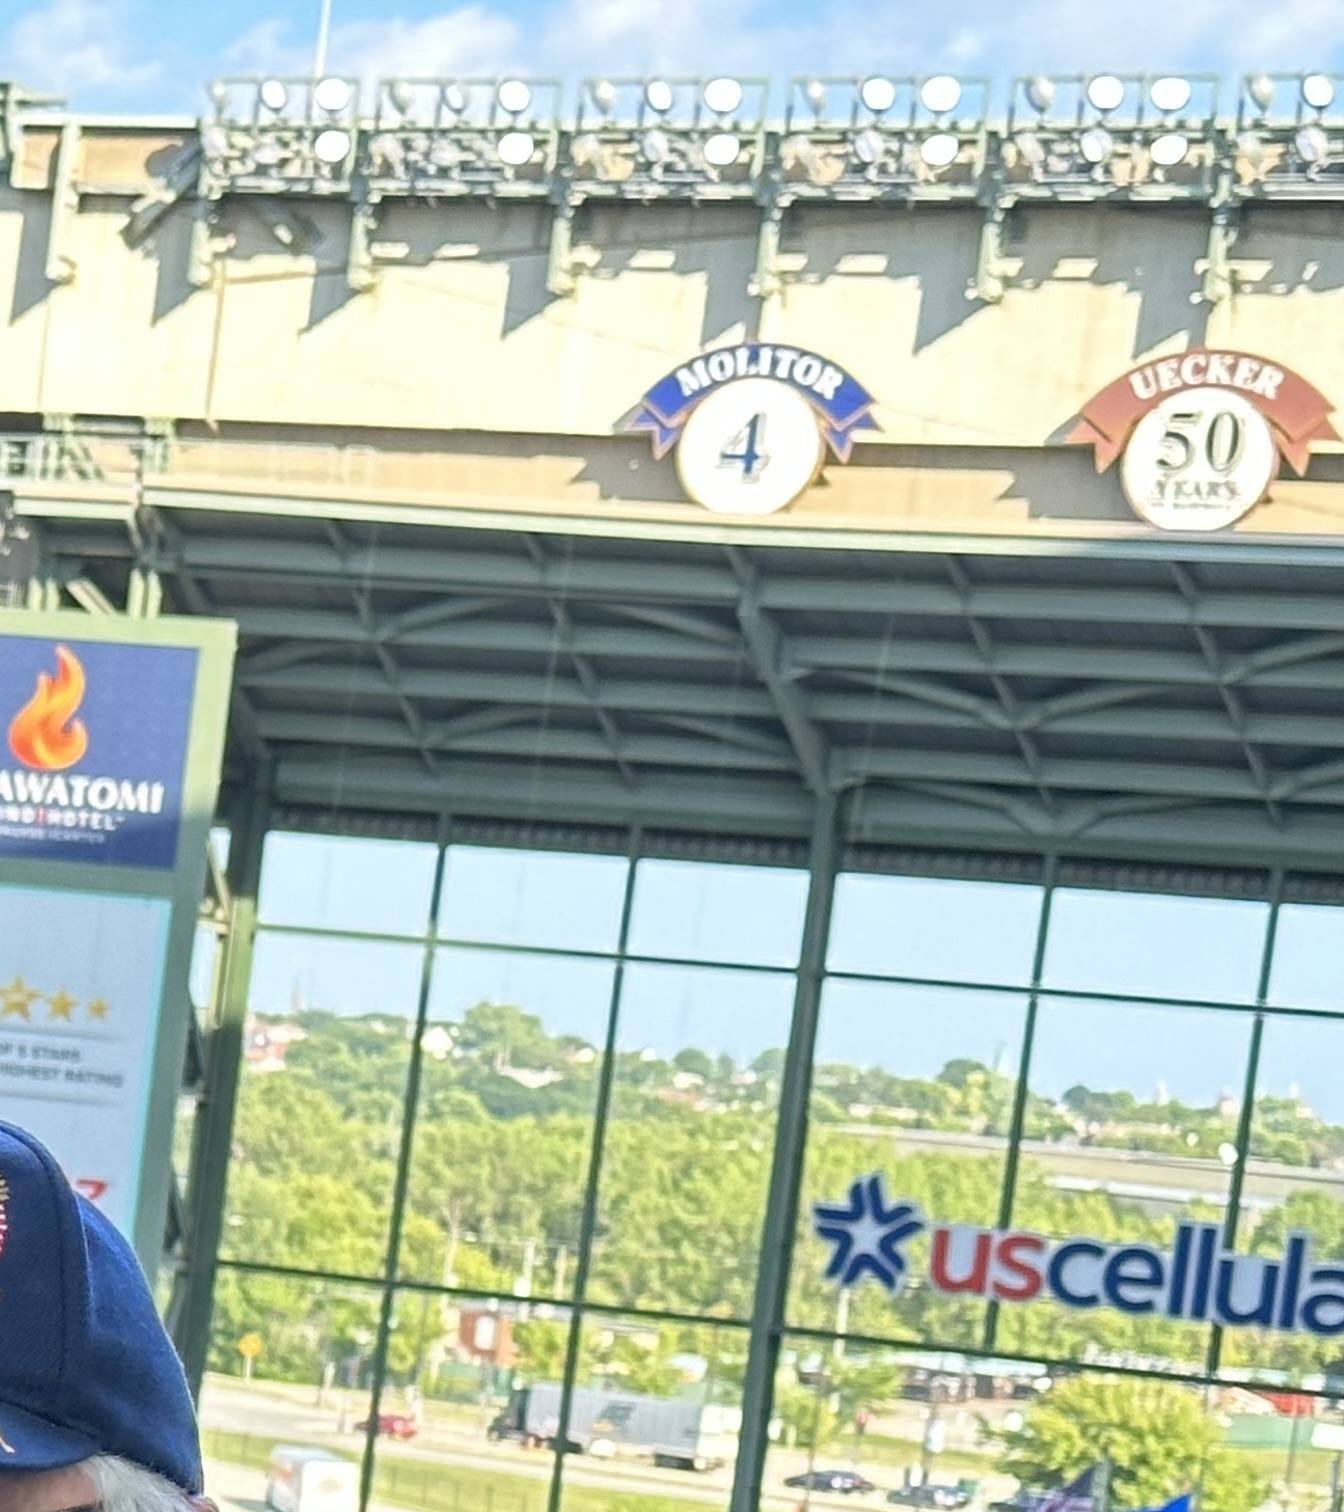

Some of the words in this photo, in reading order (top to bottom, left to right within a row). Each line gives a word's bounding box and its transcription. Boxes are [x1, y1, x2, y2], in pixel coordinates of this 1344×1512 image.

[673, 347, 843, 400] MOLITOR
[1129, 354, 1285, 400] UECKER
[716, 411, 771, 484] 4
[1157, 411, 1247, 476] 50
[1155, 479, 1241, 501] YEARS
[46, 809, 116, 831] HOTEL
